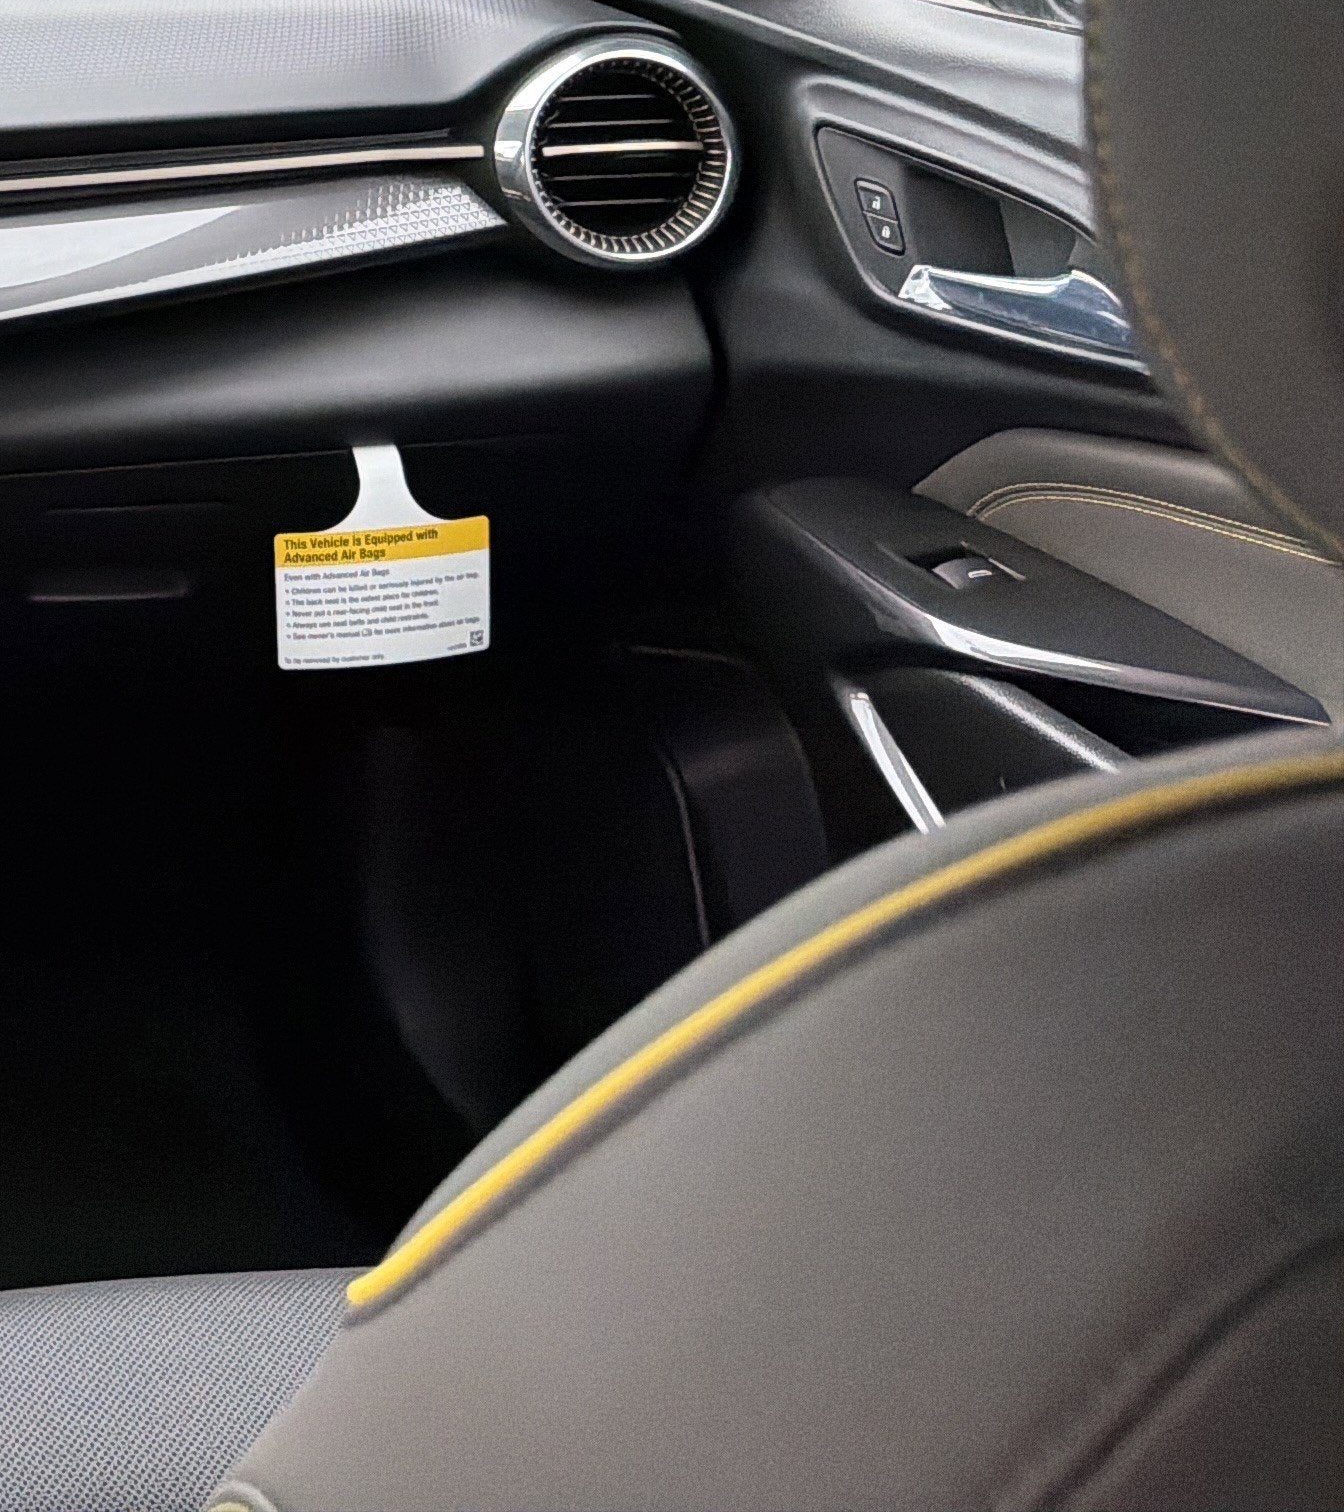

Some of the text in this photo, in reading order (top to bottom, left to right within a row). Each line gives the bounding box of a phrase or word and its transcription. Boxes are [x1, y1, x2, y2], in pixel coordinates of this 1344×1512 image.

[284, 529, 439, 551] This Vehicle is Equipped with
[284, 548, 386, 563] Advanced Air Bags
